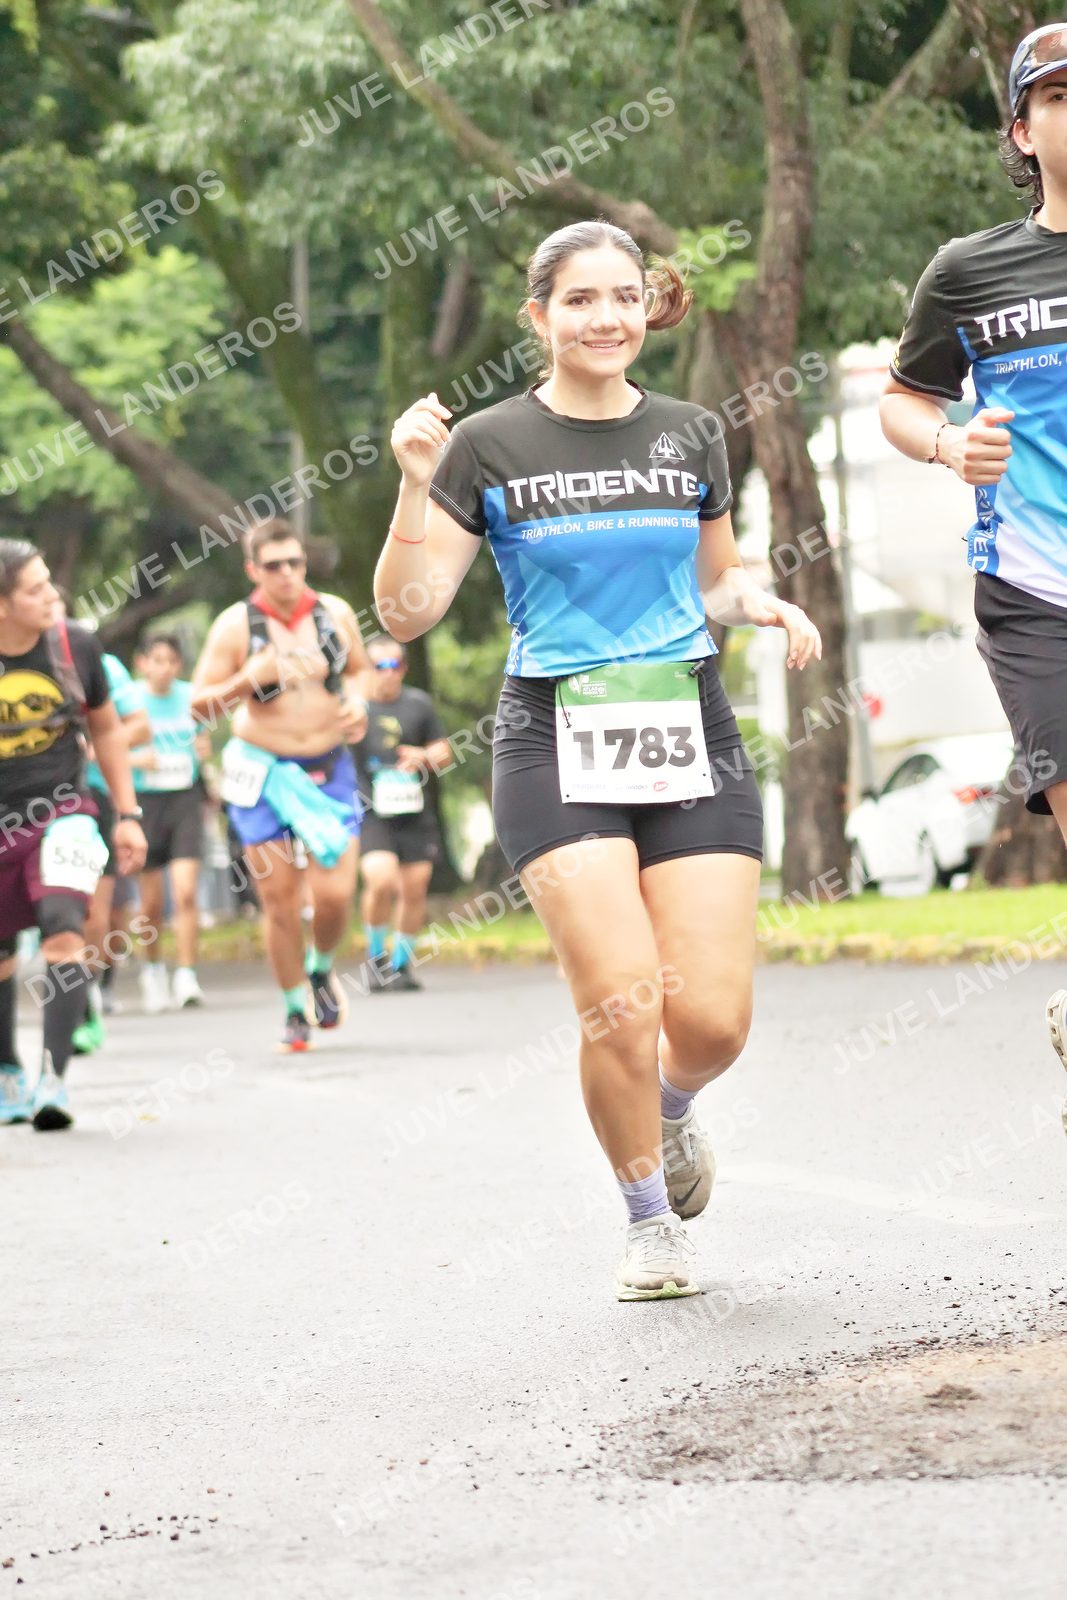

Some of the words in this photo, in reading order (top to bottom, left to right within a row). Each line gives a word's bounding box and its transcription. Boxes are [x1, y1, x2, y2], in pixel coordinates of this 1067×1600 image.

[507, 469, 700, 509] TRIDENTE
[521, 521, 585, 541] TRIATHLON,
[586, 517, 612, 532] BIKE
[616, 516, 626, 529] &
[628, 515, 679, 529] RUNNING
[573, 726, 697, 770] 1783
